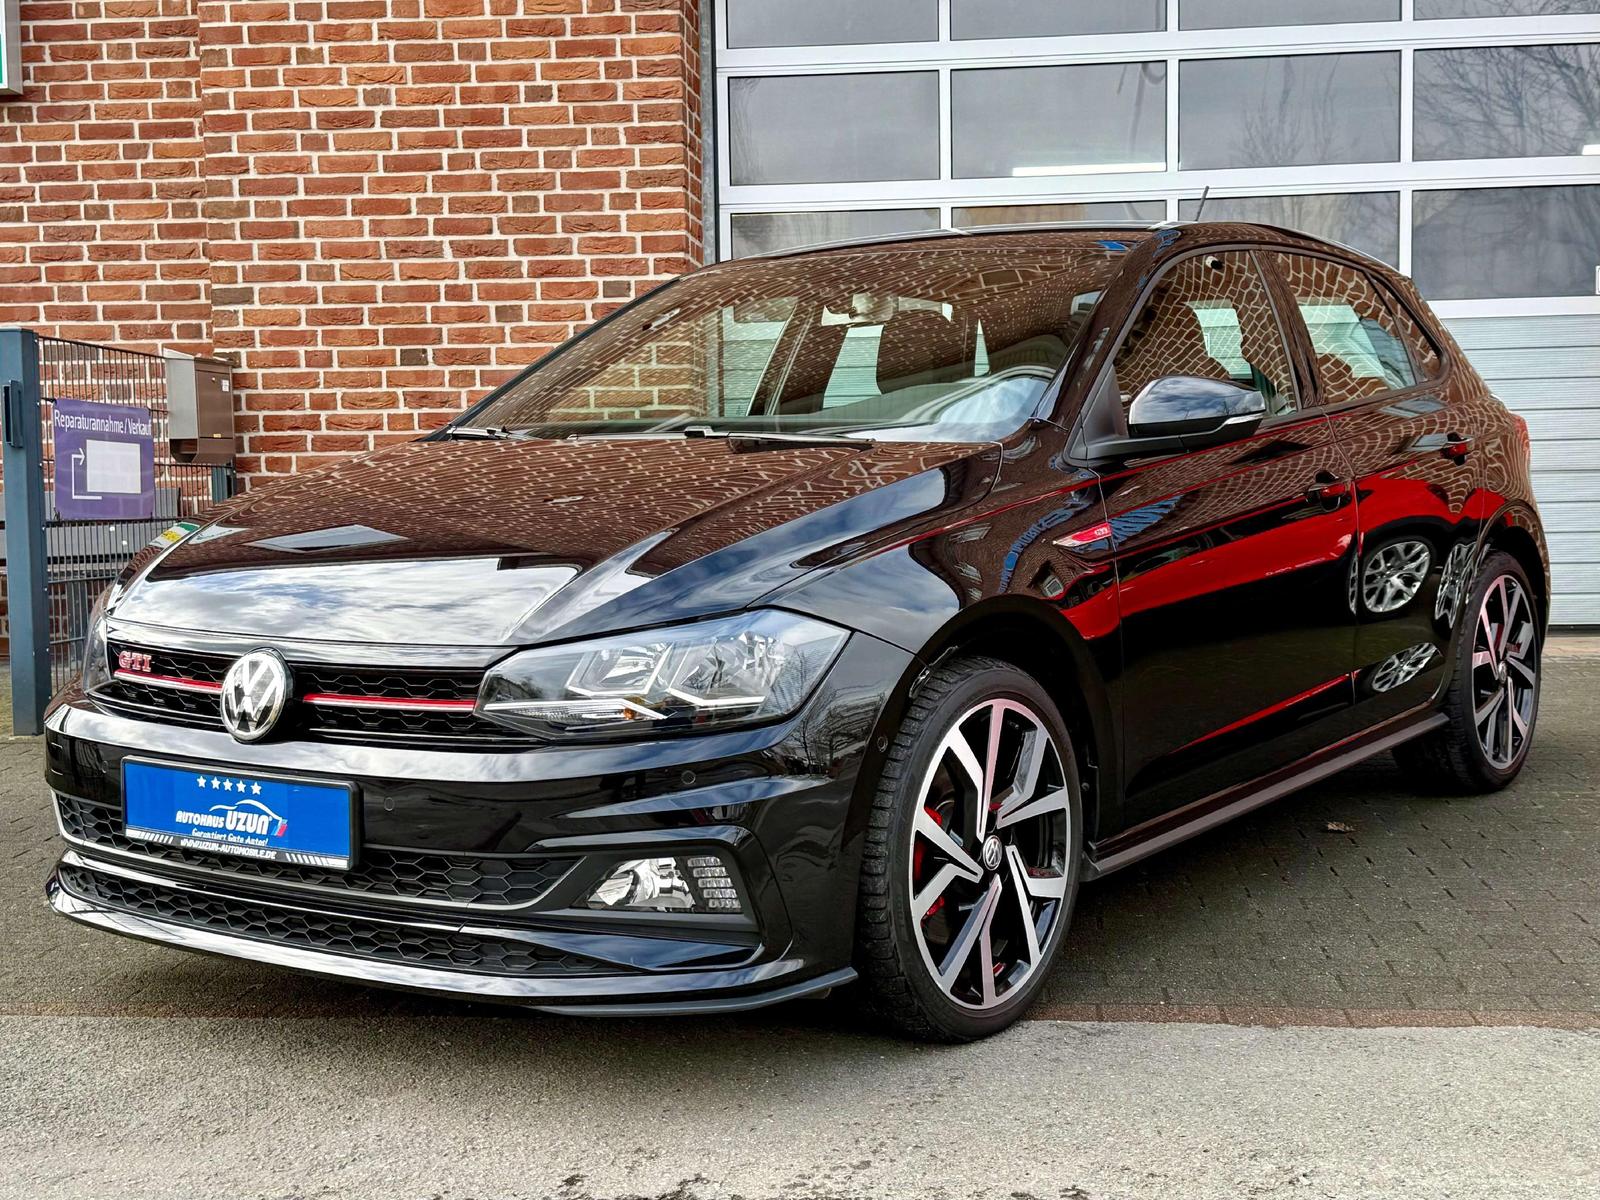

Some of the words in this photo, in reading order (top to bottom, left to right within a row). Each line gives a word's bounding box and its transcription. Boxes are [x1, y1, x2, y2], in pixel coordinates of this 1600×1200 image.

[54, 409, 124, 433] Reparaturannahme
[128, 418, 152, 436] Verkauf
[118, 650, 152, 673] GTI
[175, 810, 225, 828] AUTOHAUS
[225, 810, 270, 835] UZUN
